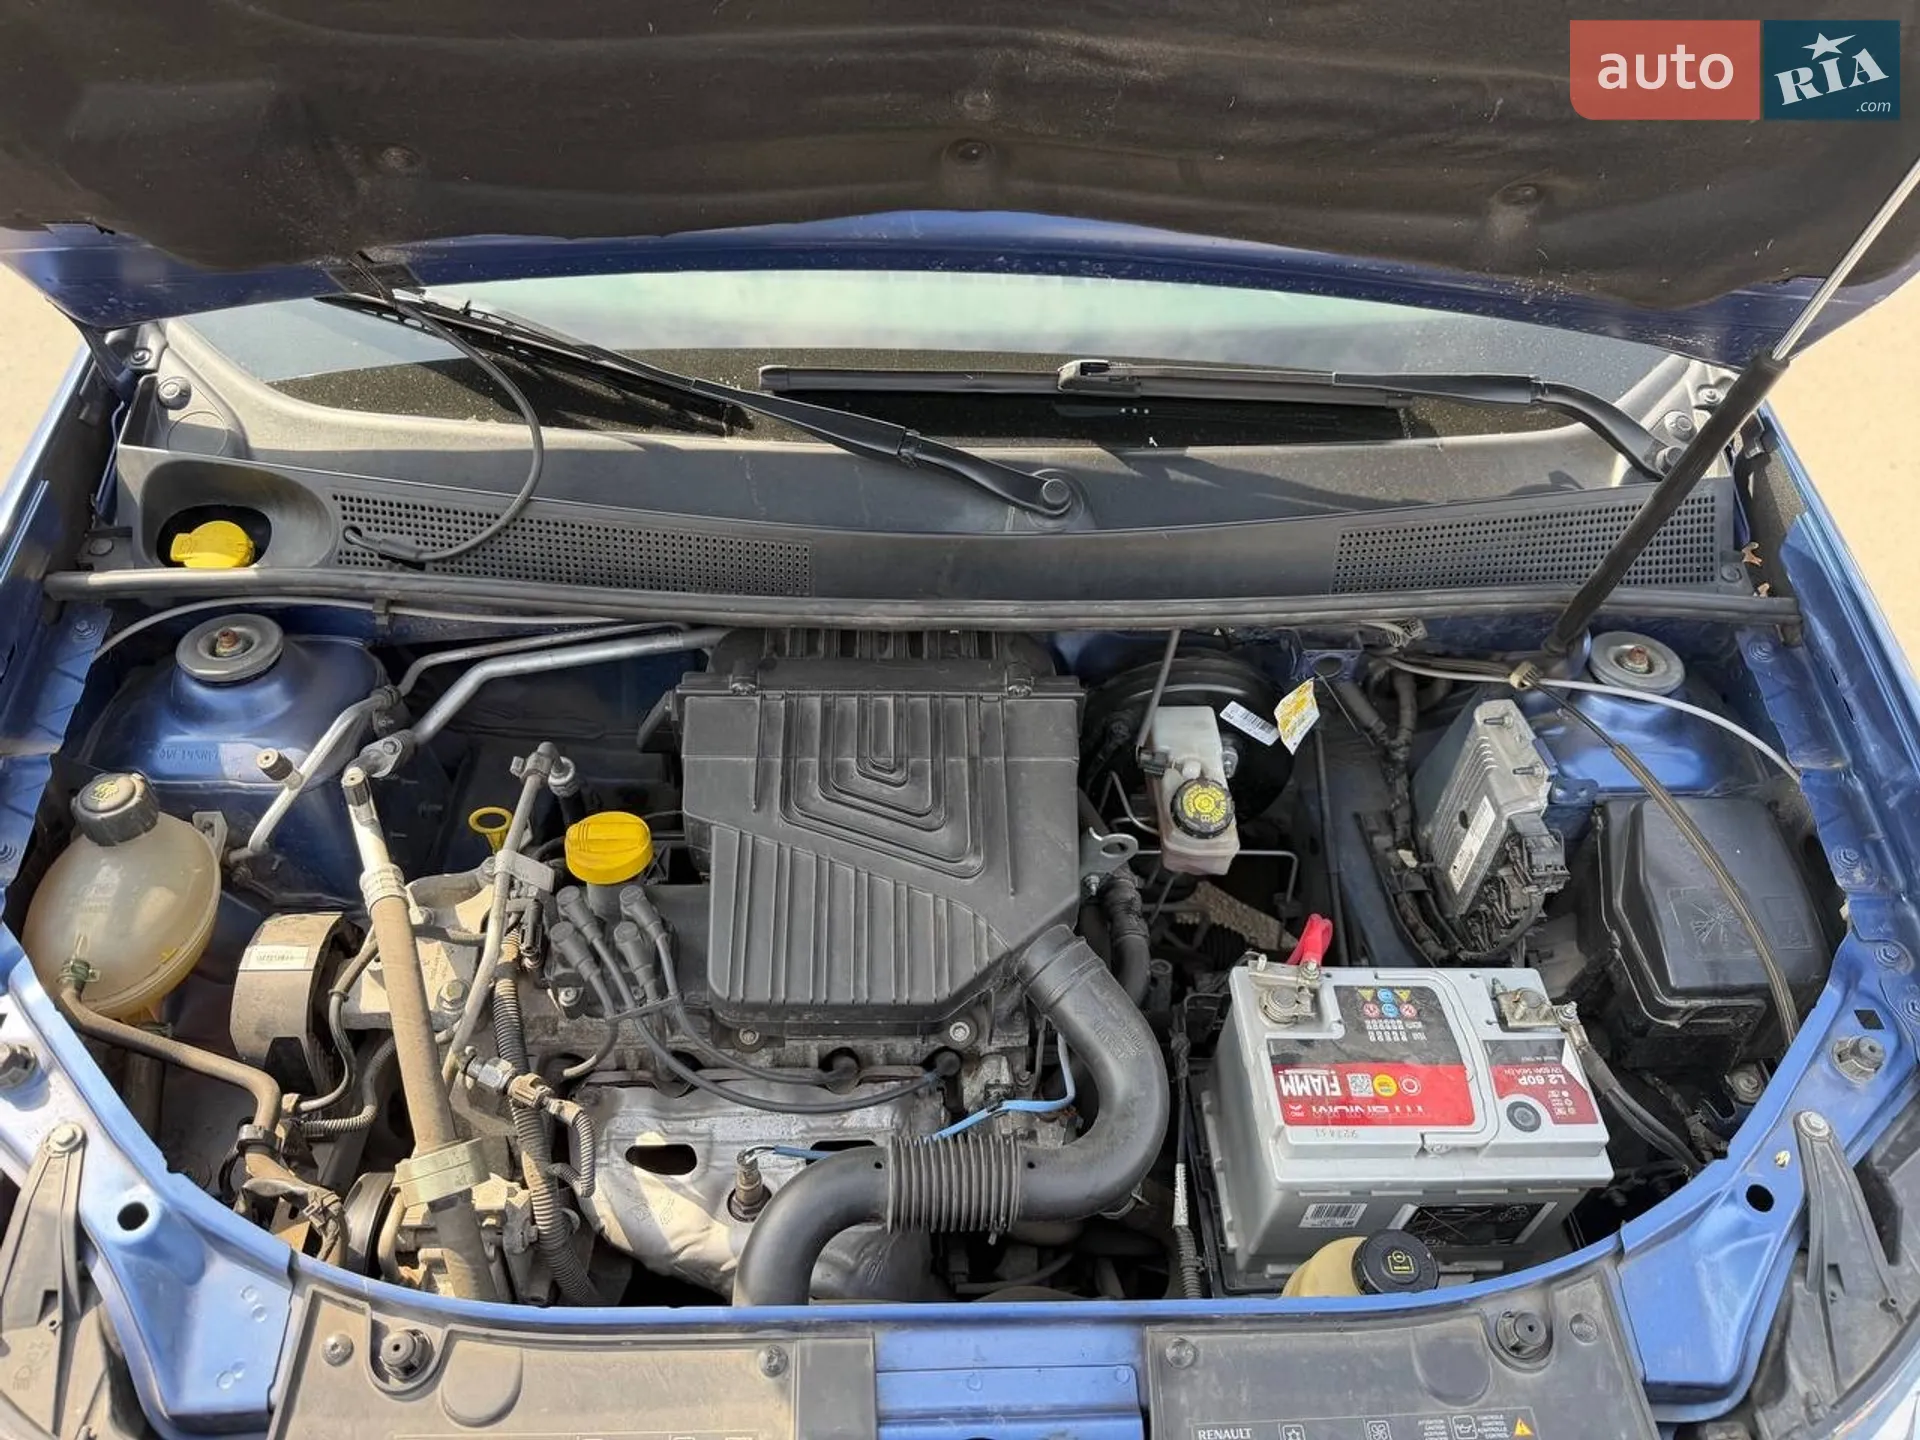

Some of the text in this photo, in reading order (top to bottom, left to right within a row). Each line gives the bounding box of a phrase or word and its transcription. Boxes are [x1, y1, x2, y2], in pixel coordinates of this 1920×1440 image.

[1278, 1074, 1342, 1097] FIAMM
[1548, 1074, 1567, 1085] L2
[1198, 1428, 1252, 1440] RENAULT
